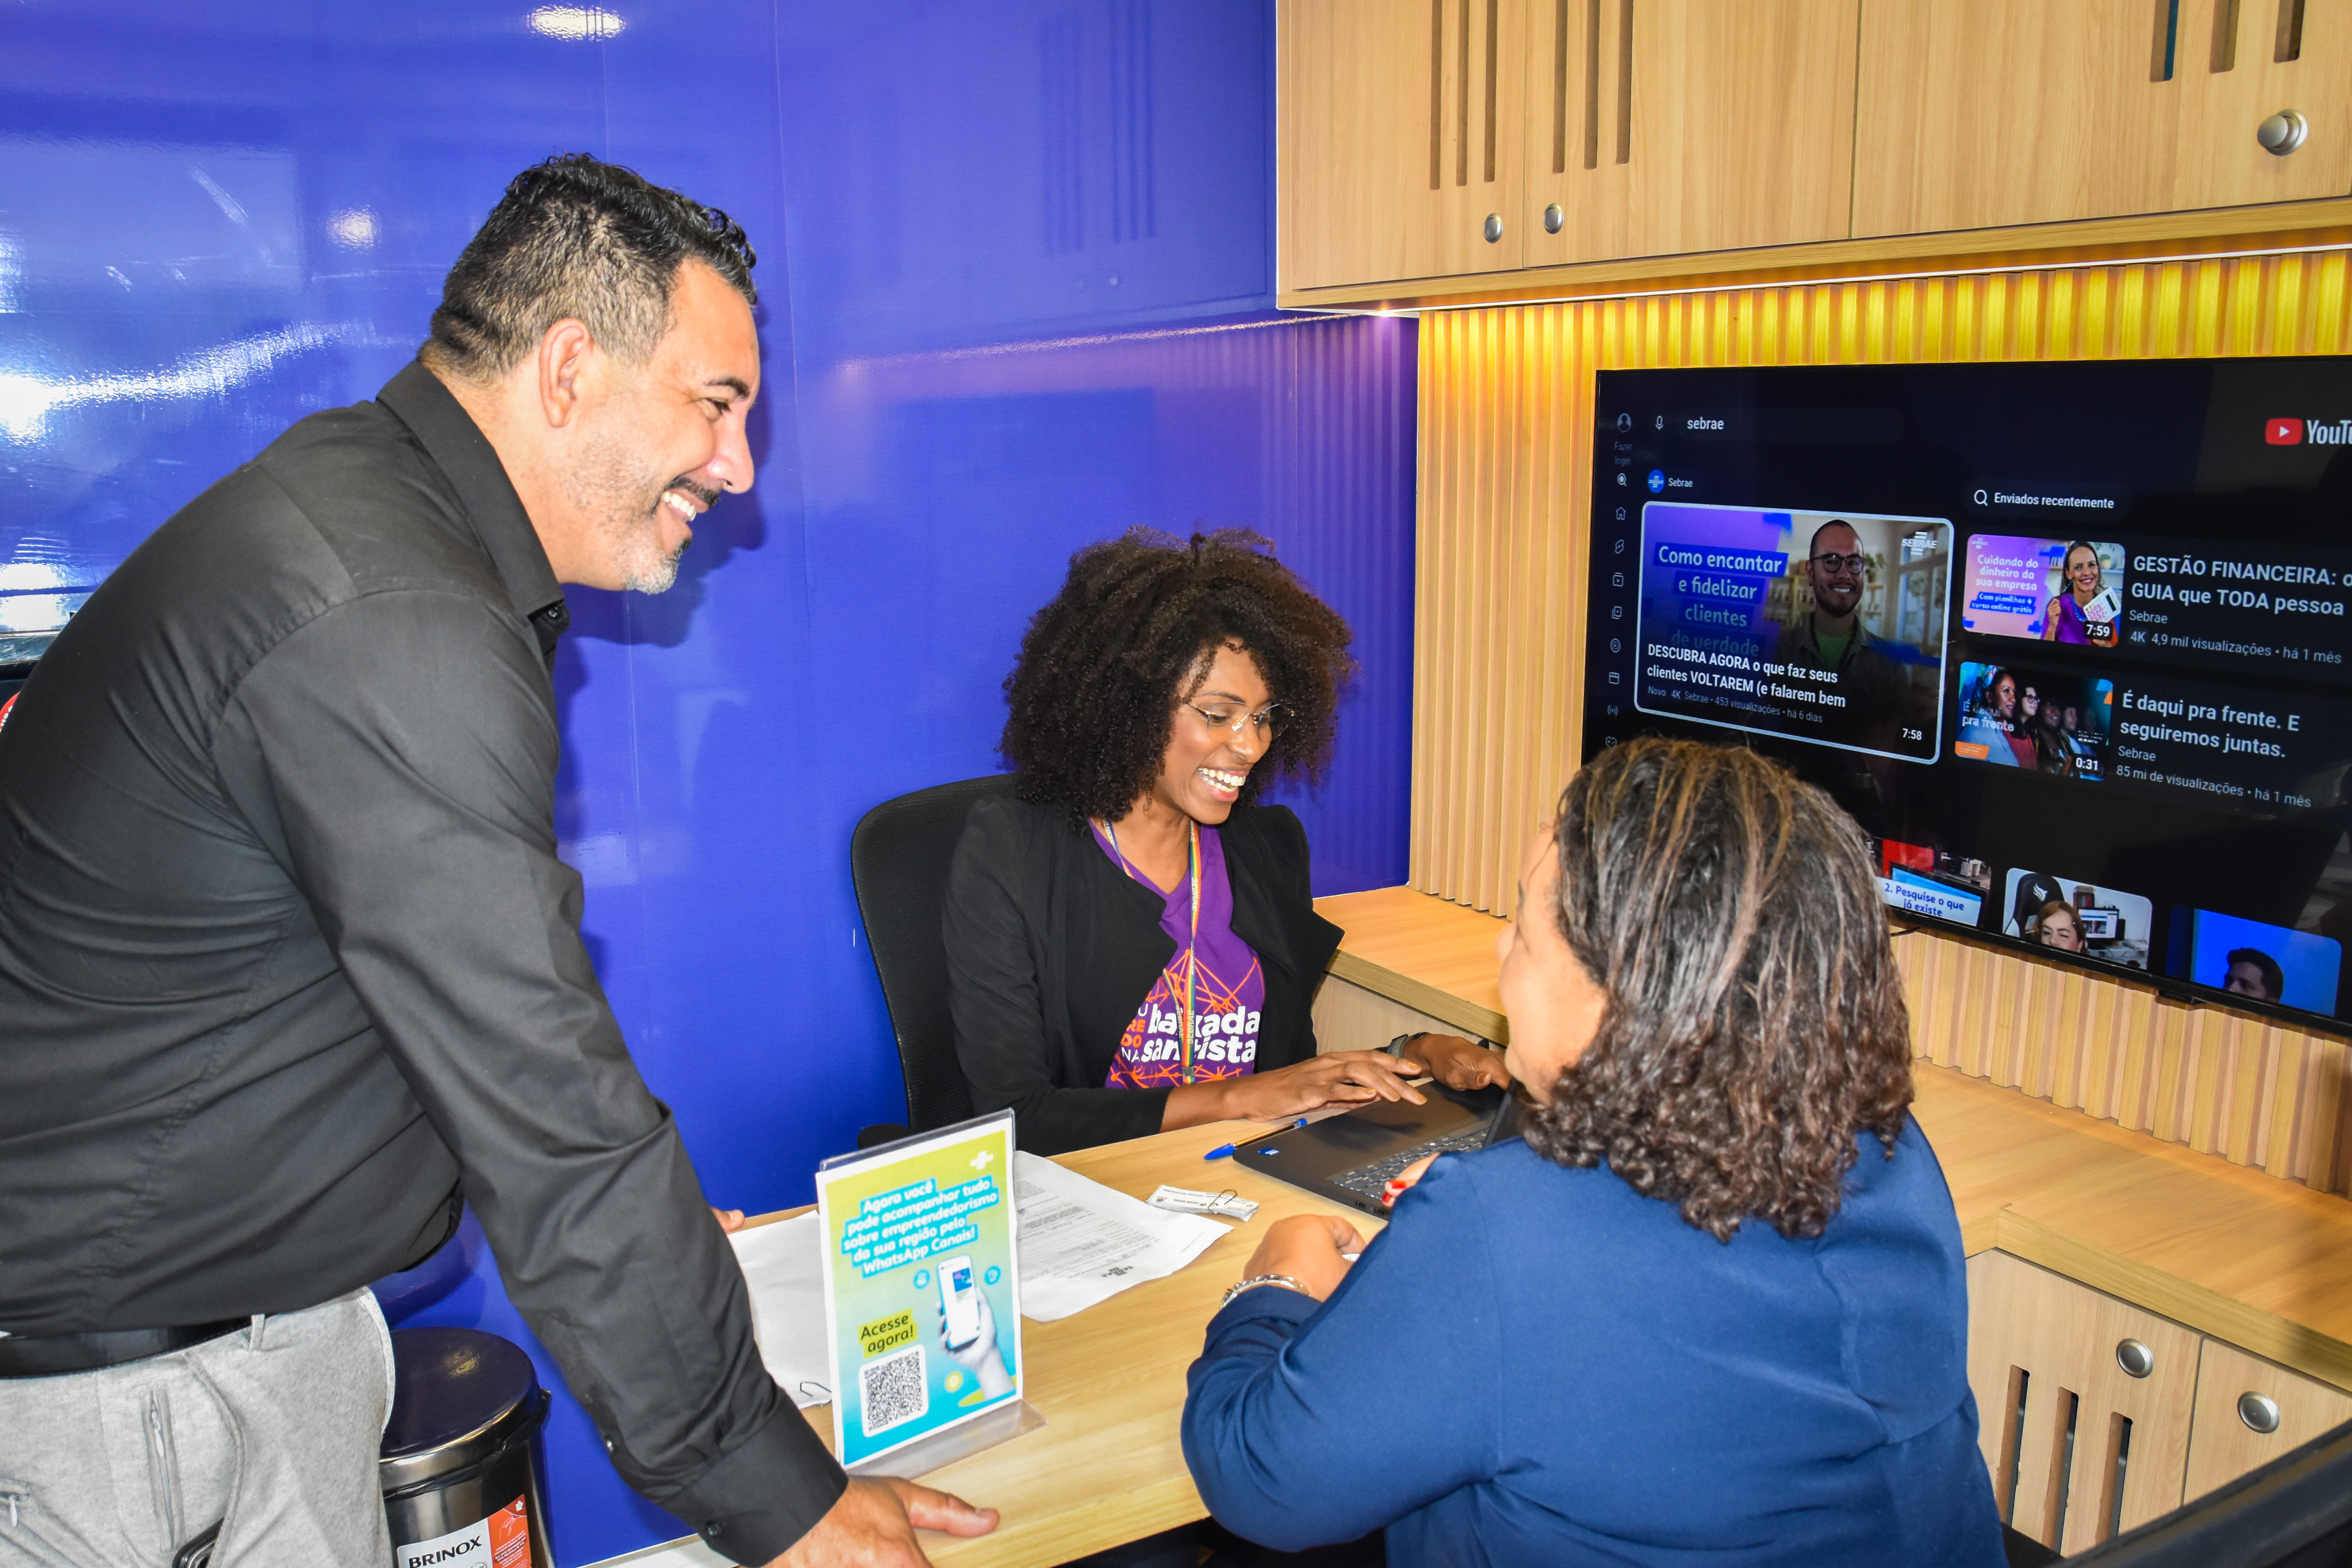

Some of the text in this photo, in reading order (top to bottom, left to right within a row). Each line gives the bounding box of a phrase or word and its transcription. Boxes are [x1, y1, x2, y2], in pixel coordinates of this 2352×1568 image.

[1687, 417, 1724, 429] sebrae
[1615, 442, 1632, 450] Fazer
[1615, 456, 1631, 466] login
[1668, 478, 1693, 487] Sebrae
[1994, 493, 2114, 509] Enviados recentemente
[1902, 538, 1938, 549] SEBRAE
[1659, 546, 1782, 573] Como encantar
[1977, 555, 2038, 568] Cuidando do
[2134, 555, 2206, 575] GESTÃO
[2211, 561, 2336, 585] FINANCEIRA:
[1979, 566, 2034, 579] dinheiro da
[1679, 576, 1757, 599] e fidelizar
[1995, 580, 2037, 591] empresa
[1995, 594, 2026, 604] planilhas
[2012, 604, 2032, 614] grátis
[2132, 583, 2343, 615] GUIA que TODA pessoa
[1685, 604, 1747, 627] clientes
[2129, 610, 2168, 624] Sebrae
[2086, 624, 2110, 637] 7:59
[1672, 629, 1759, 657] de verdade
[2130, 631, 2342, 664] 4K 4,9 mil visualizações há 1 mês
[1648, 644, 1838, 683] DESCUBRA AGORA o que faz seus
[1647, 665, 1846, 707] clientes VOLTAREM (e falarem bem
[1648, 686, 1822, 723] Novo 4K Sebrae 453 visualizações há 6 dias
[2123, 690, 2300, 732] É daqui pra frente. E
[1902, 728, 1922, 740] 7:58
[1962, 716, 2014, 732] pra frente
[2120, 722, 2219, 748] seguiremos
[2223, 733, 2286, 757] juntas.
[2076, 758, 2098, 771] 0:31
[2118, 746, 2156, 761] Sebrae
[2116, 765, 2311, 808] 85 mi de visualizações há 1 mês
[1885, 883, 1892, 893] 2.
[1896, 885, 1935, 903] Pesquise
[1947, 901, 1964, 911] que
[1903, 899, 1943, 917] já existe
[1121, 1047, 1140, 1062] NA
[848, 1215, 879, 1237] pode
[882, 1189, 960, 1223] acompanhar
[963, 1180, 990, 1197] tudo
[863, 1180, 933, 1214] Agora você
[844, 1231, 879, 1250] sobre
[881, 1192, 997, 1238] empreendedorismo
[854, 1216, 965, 1262] da sua região pelo
[863, 1227, 975, 1274] WhatsApp Canais!
[861, 1315, 908, 1340] Acesse
[868, 1325, 913, 1352] agora!
[409, 1535, 482, 1568] BRINOX
